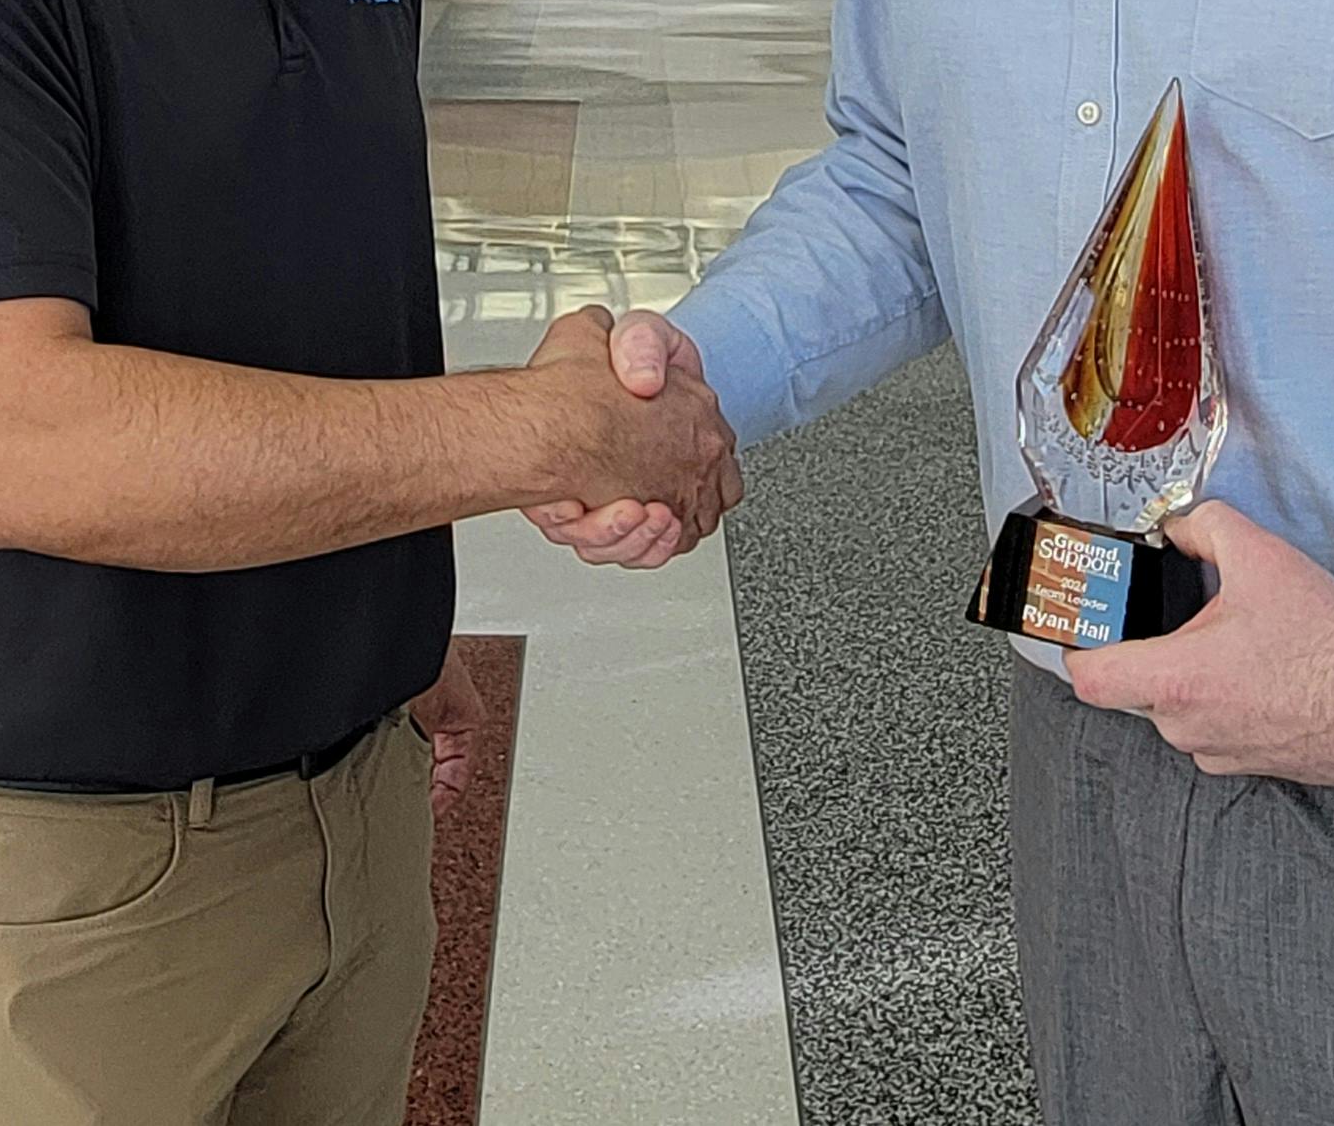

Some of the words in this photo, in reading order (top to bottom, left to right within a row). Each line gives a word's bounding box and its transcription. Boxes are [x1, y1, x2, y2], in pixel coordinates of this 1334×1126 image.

[1039, 538, 1121, 578] Support
[1054, 533, 1118, 561] Ground
[1022, 604, 1069, 631] Ryan
[1074, 617, 1110, 642] Hall
